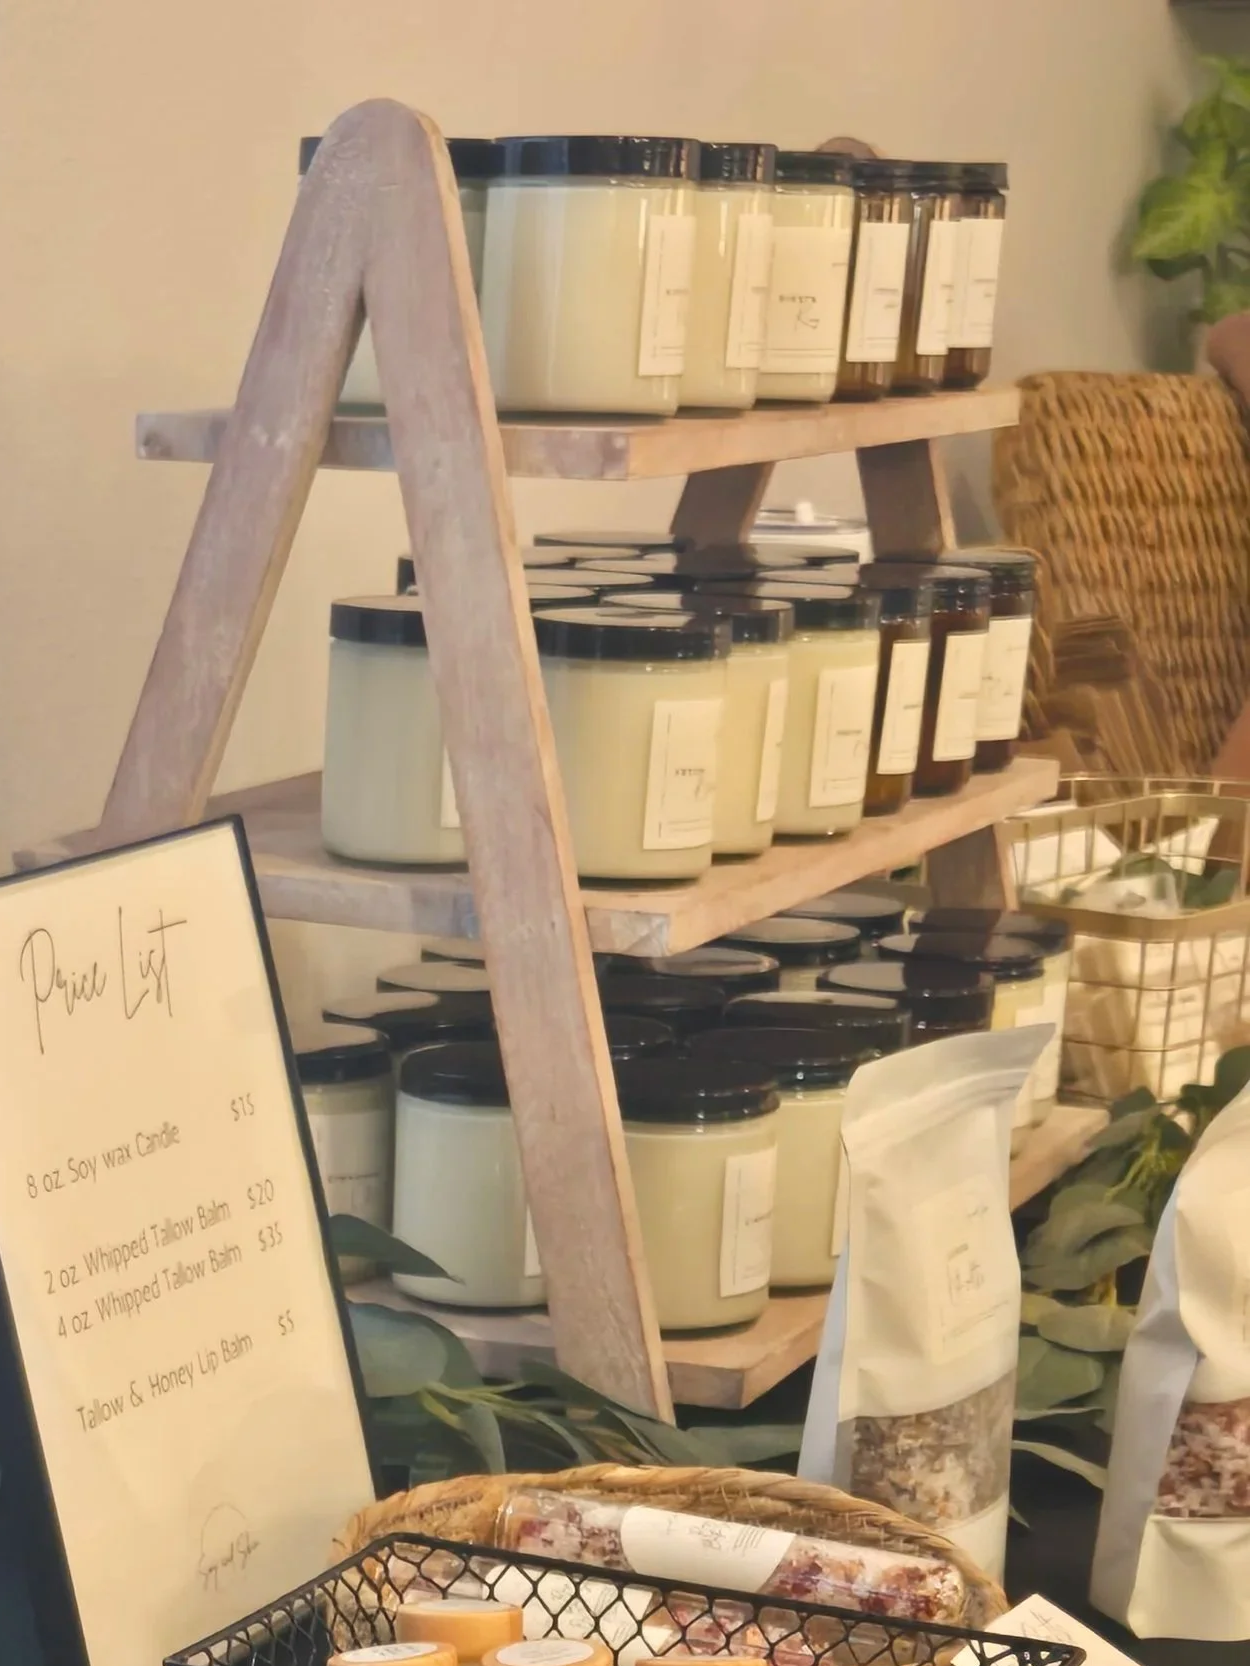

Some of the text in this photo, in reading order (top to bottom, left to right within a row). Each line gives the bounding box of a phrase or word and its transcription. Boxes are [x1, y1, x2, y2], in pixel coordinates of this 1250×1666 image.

[20, 906, 187, 1055] Price List
[27, 1093, 255, 1198] 8 oz Soy wax Candle $15
[44, 1179, 274, 1294] 2 oz Whipped Tallow Balm $20
[58, 1222, 283, 1339] 4 oz Whipped Tallow Balm $35
[76, 1310, 294, 1433] Tallow & Honey Lip Balm $5
